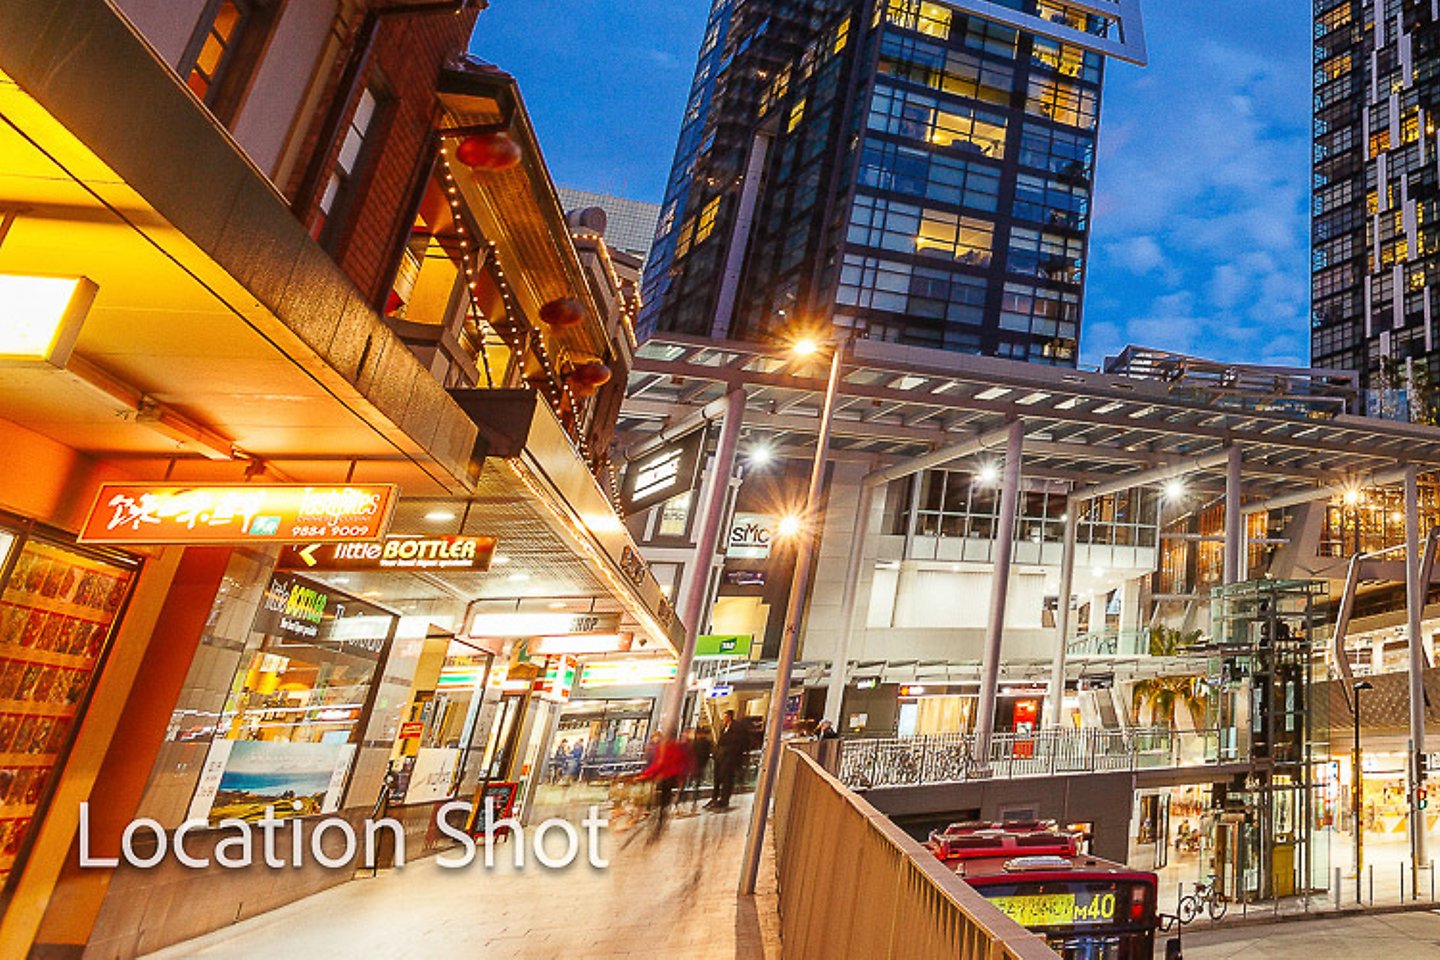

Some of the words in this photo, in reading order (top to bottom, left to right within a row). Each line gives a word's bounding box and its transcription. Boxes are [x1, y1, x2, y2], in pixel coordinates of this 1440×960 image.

[331, 526, 368, 536] 9009
[730, 523, 770, 543] SMC
[333, 543, 382, 560] little
[383, 541, 475, 559] BOTTLER
[1073, 893, 1116, 920] M40
